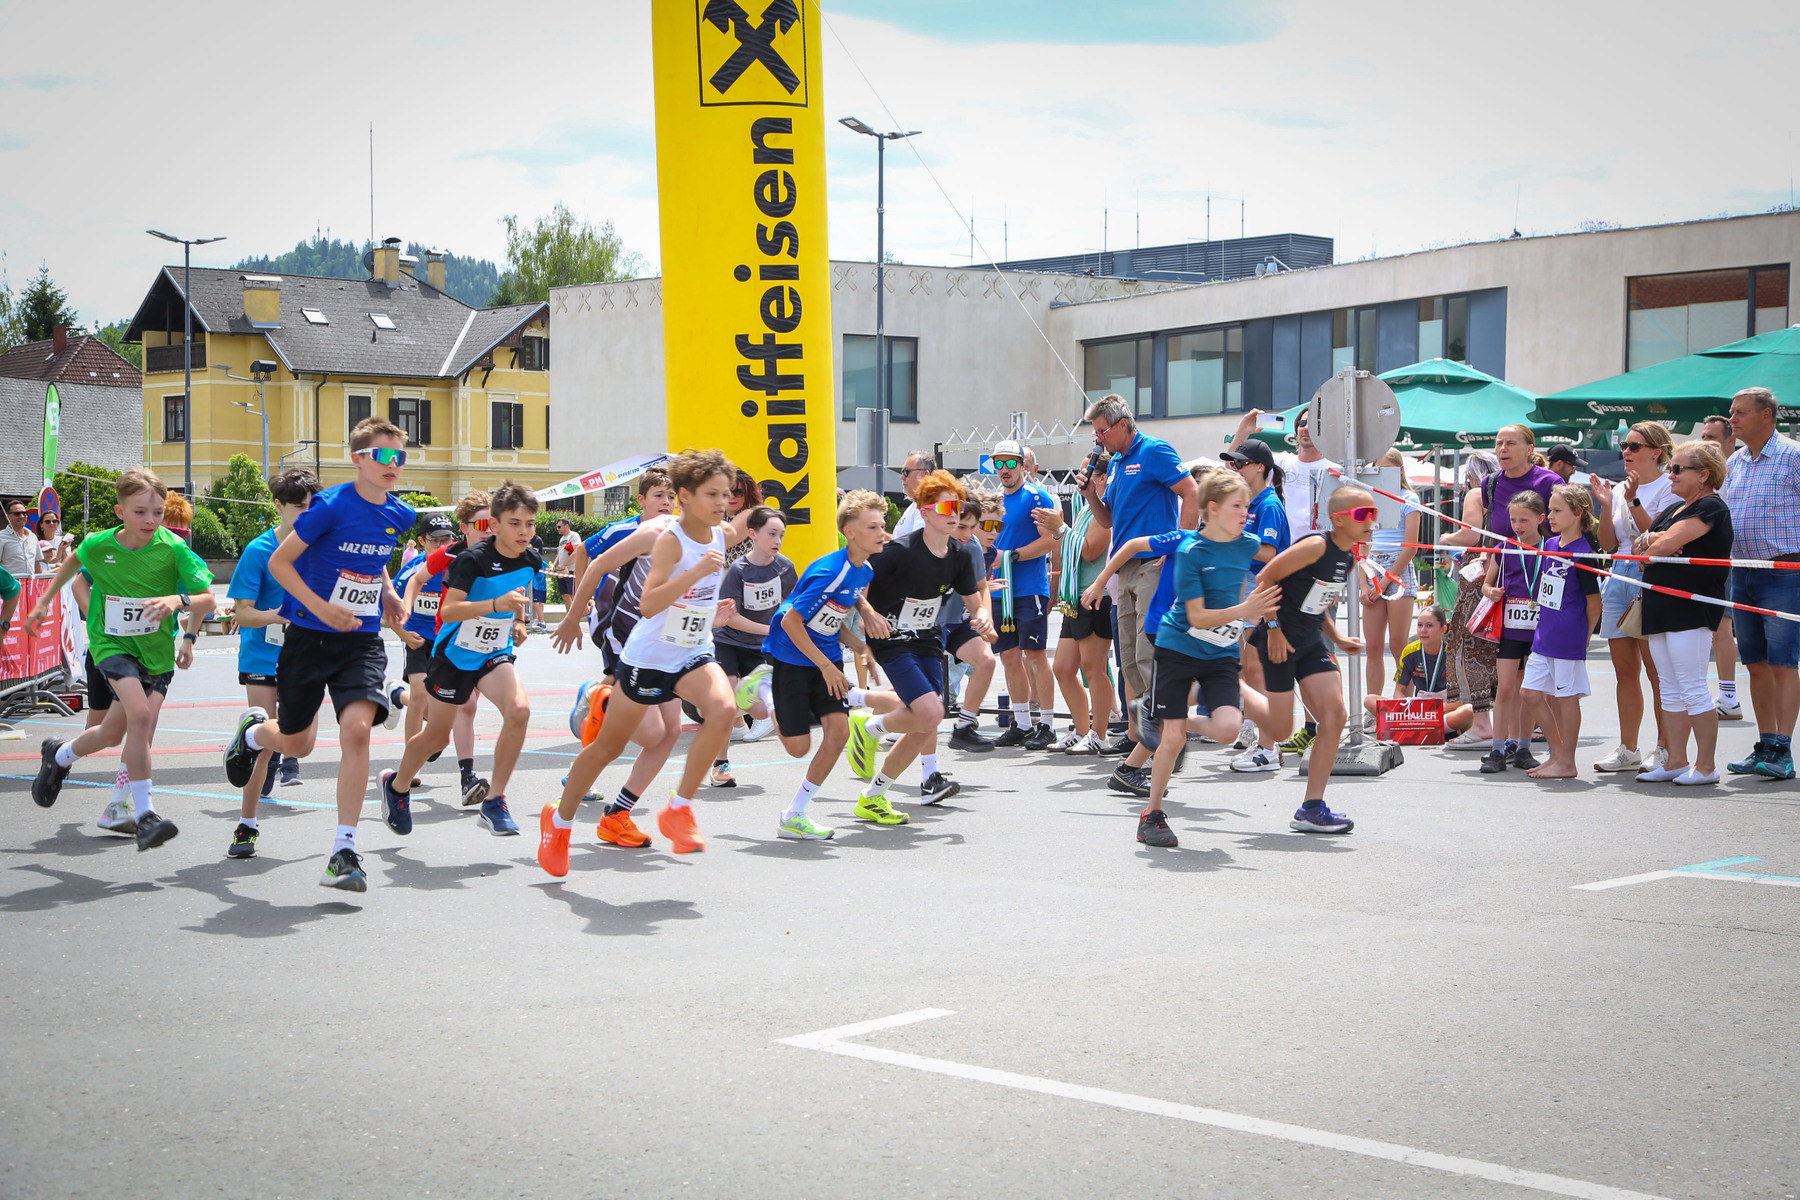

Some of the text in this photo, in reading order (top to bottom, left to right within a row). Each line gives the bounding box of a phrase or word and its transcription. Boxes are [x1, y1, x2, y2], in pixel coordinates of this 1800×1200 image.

[733, 116, 811, 526] Raiffeisen
[338, 542, 361, 554] JAZ
[338, 586, 379, 605] 10298
[754, 587, 774, 600] 156
[123, 608, 144, 622] 57
[912, 607, 935, 618] 149
[474, 626, 500, 641] 165
